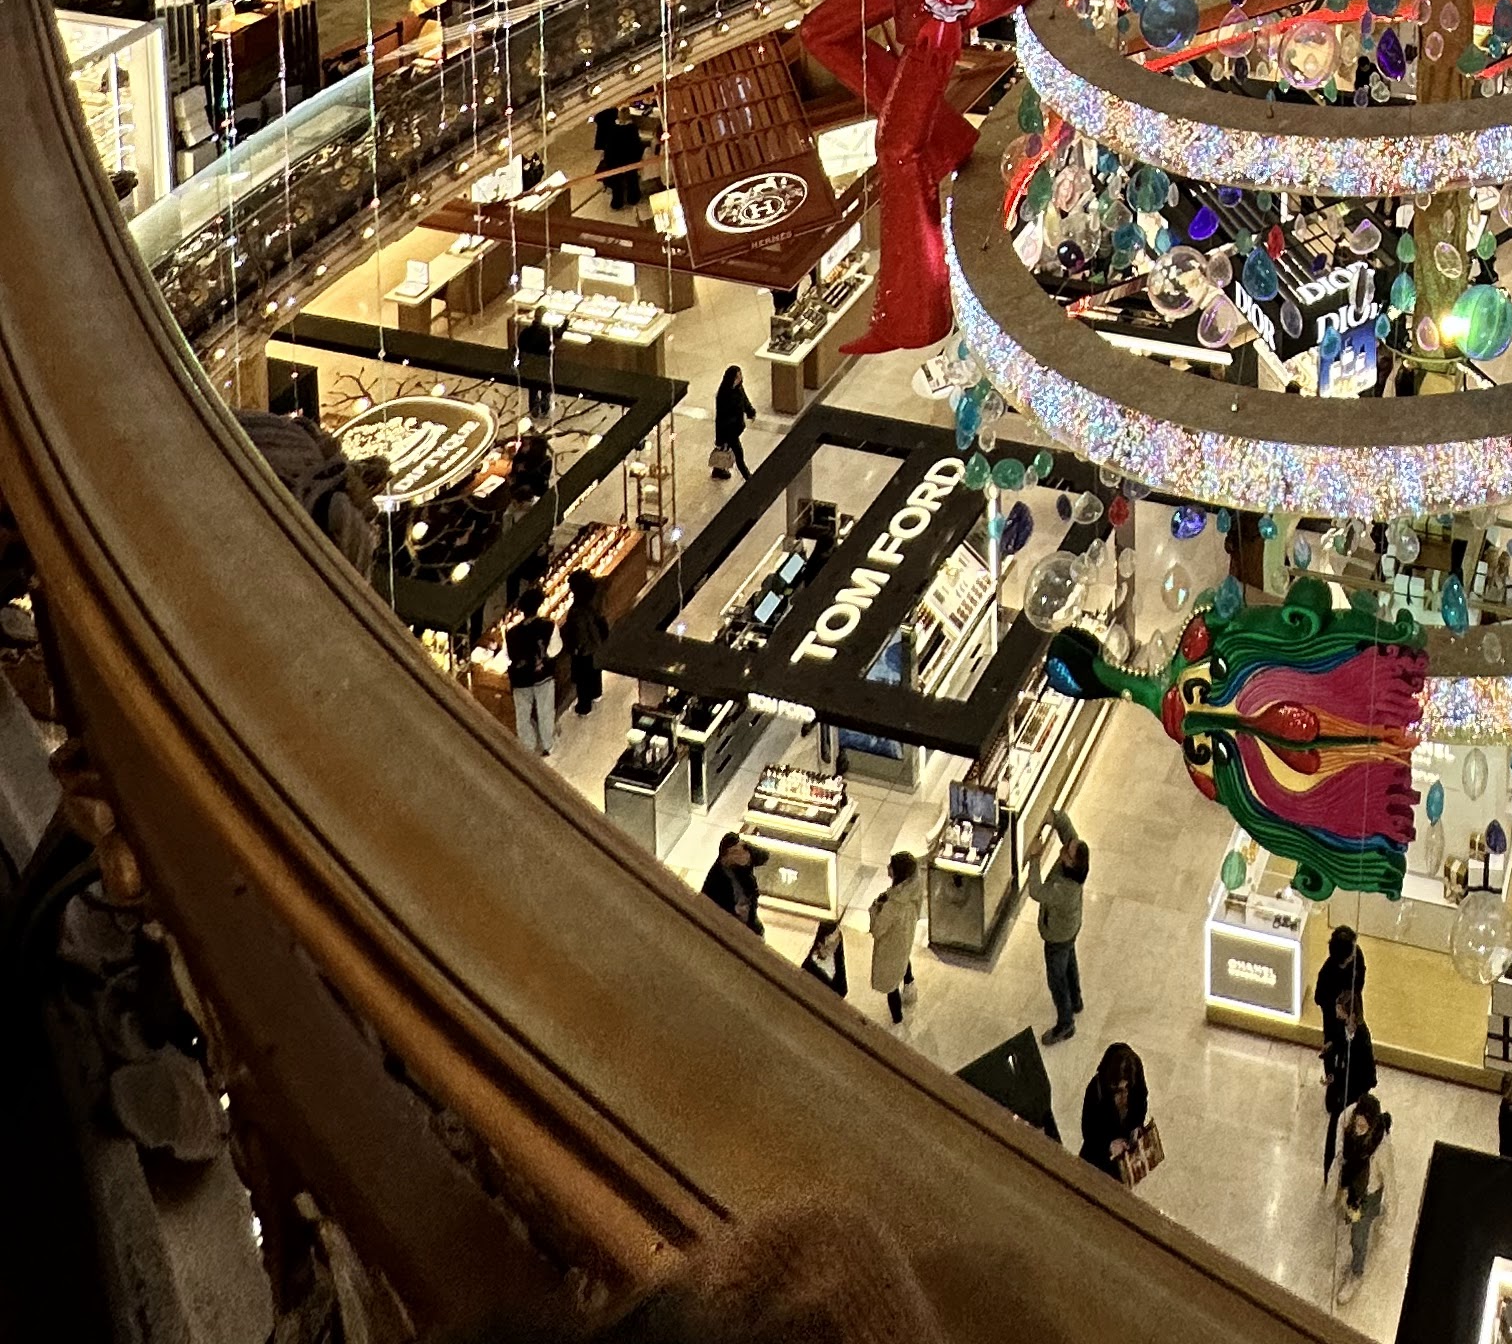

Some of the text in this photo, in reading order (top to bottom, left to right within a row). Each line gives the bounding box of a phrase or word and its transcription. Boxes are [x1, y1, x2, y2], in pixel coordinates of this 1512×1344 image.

[1235, 281, 1276, 351] DIOR
[789, 457, 966, 663] TOM FORD
